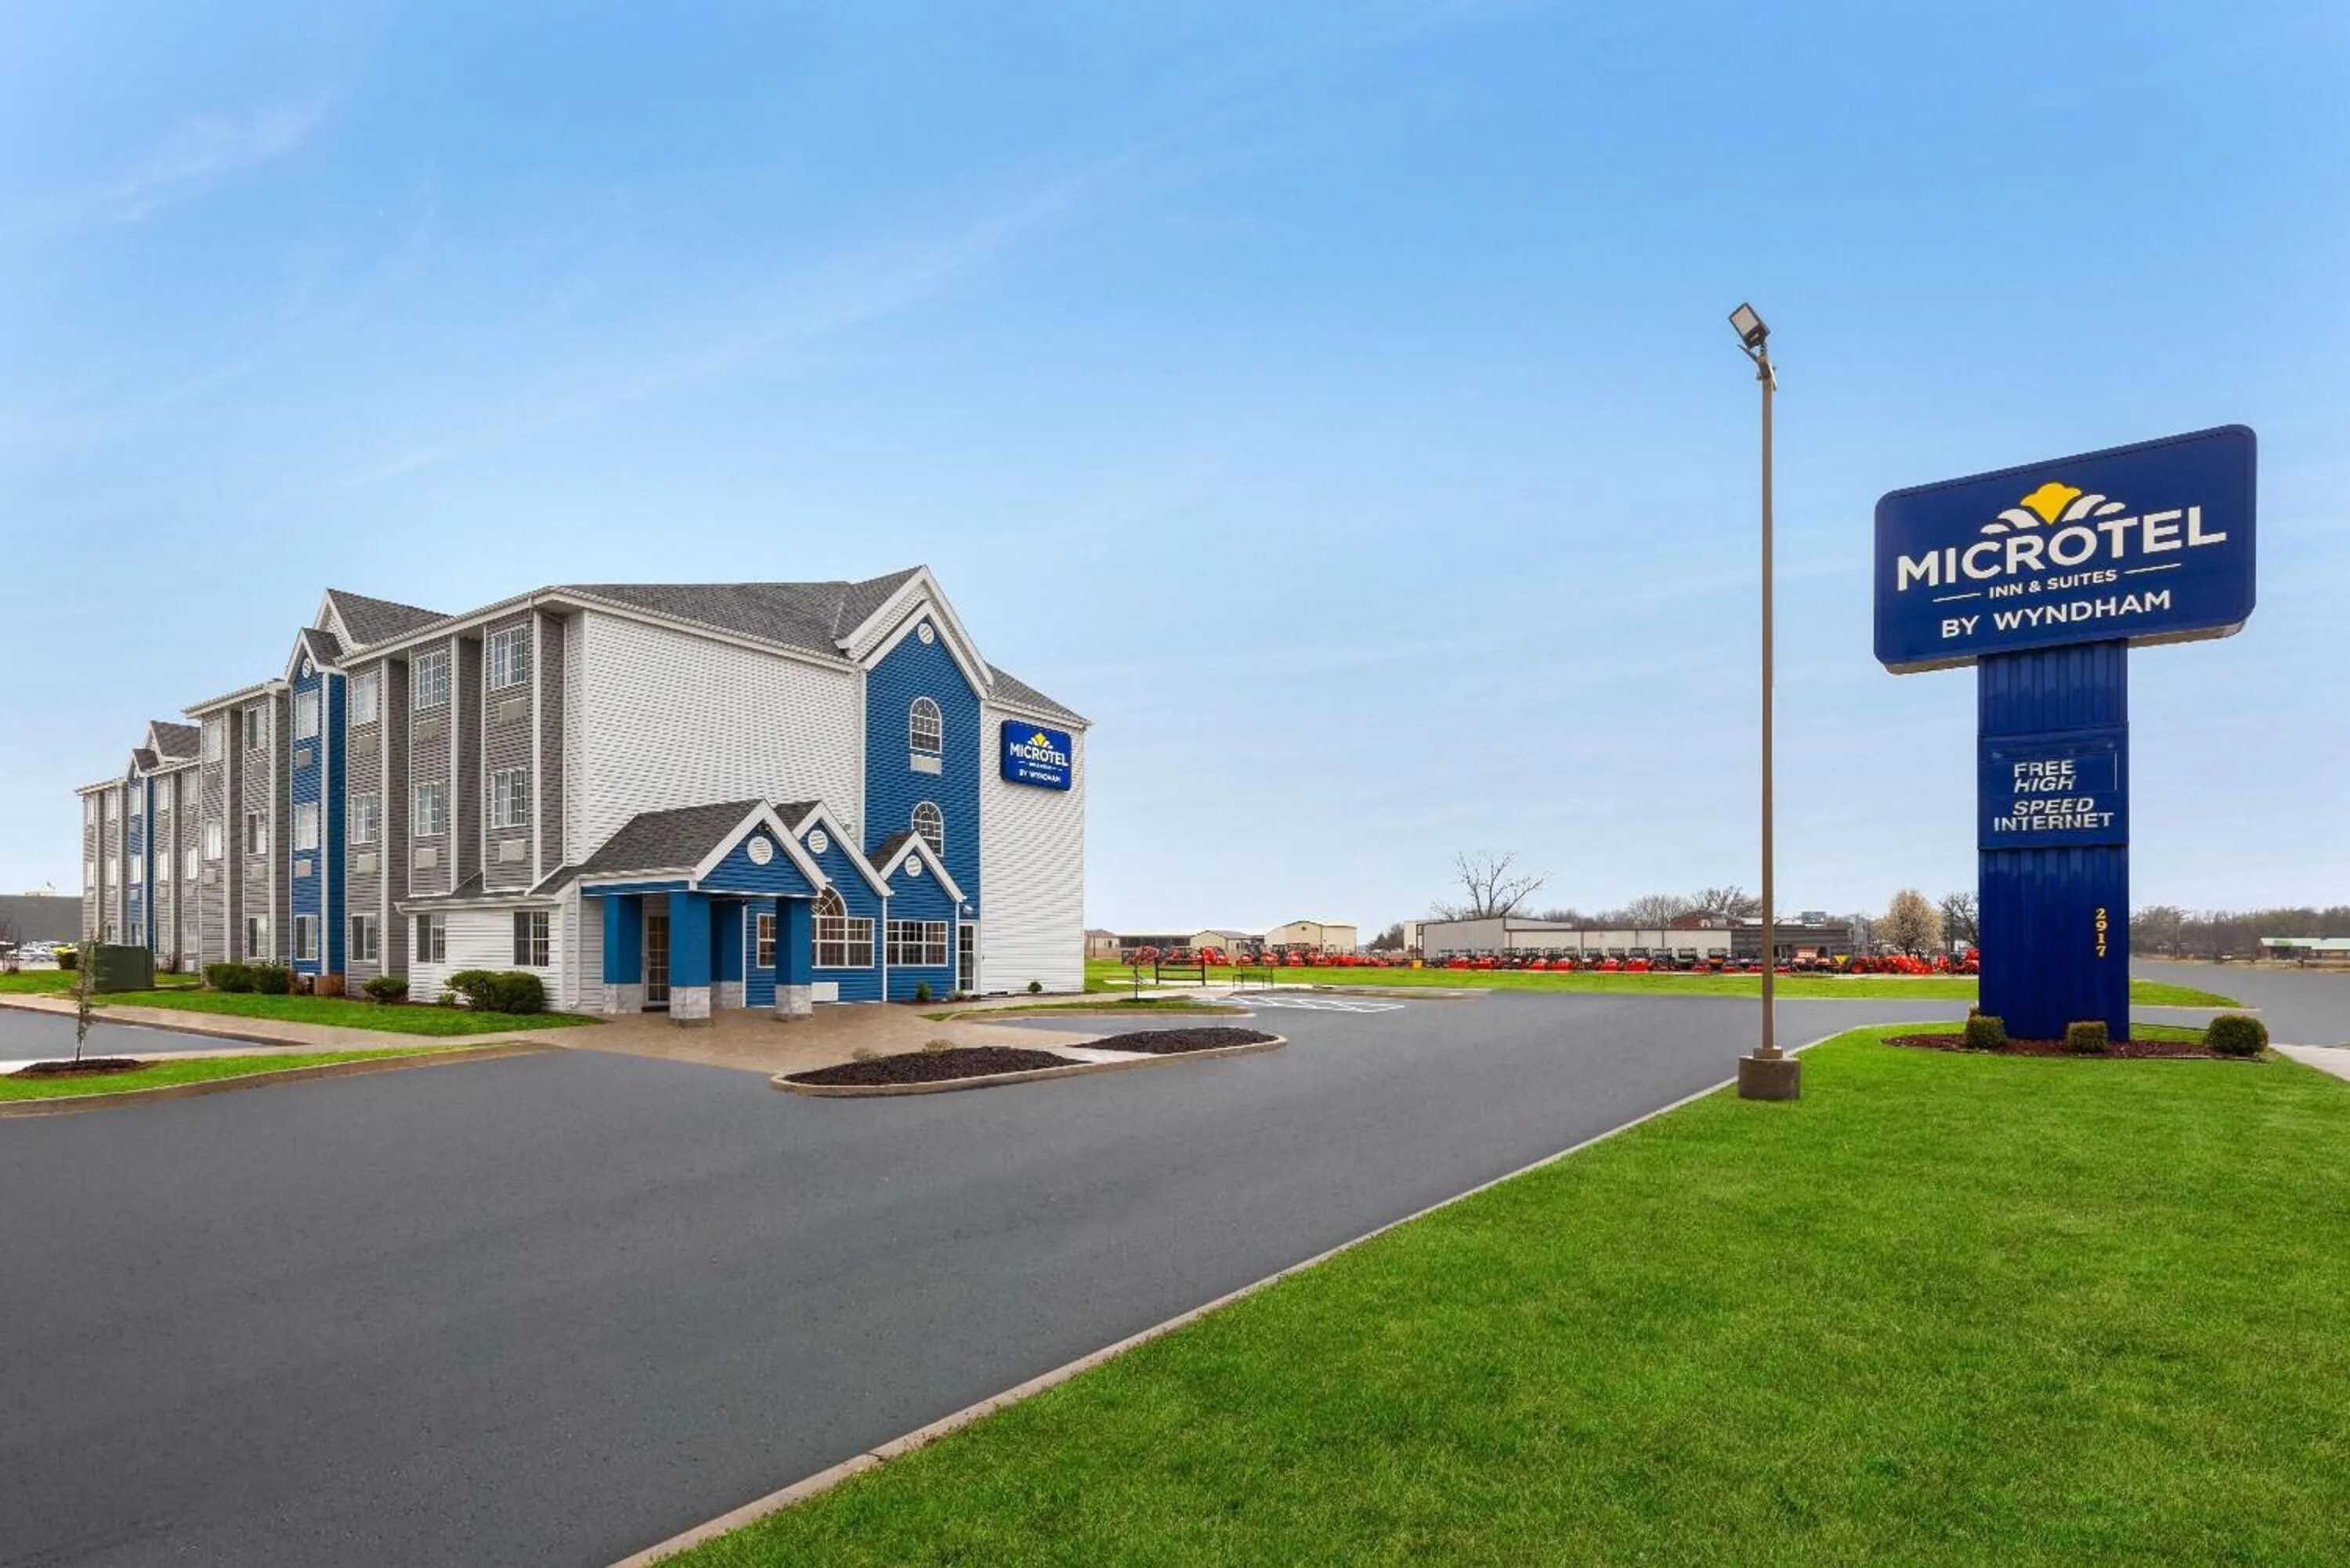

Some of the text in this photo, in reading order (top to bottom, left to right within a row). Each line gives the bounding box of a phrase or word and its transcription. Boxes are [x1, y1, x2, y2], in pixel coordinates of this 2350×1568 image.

[1896, 505, 2227, 591] MICROTEL
[1989, 569, 2117, 599] INN & SUITES
[1942, 589, 2171, 638] BY WYNDHAM
[1010, 742, 1069, 767] MICROTEL
[2014, 760, 2076, 778] FREE
[2014, 775, 2077, 793] HIGH
[2012, 797, 2094, 815] SPEED
[1994, 812, 2114, 831] INTERNET
[2095, 908, 2107, 957] 2917
